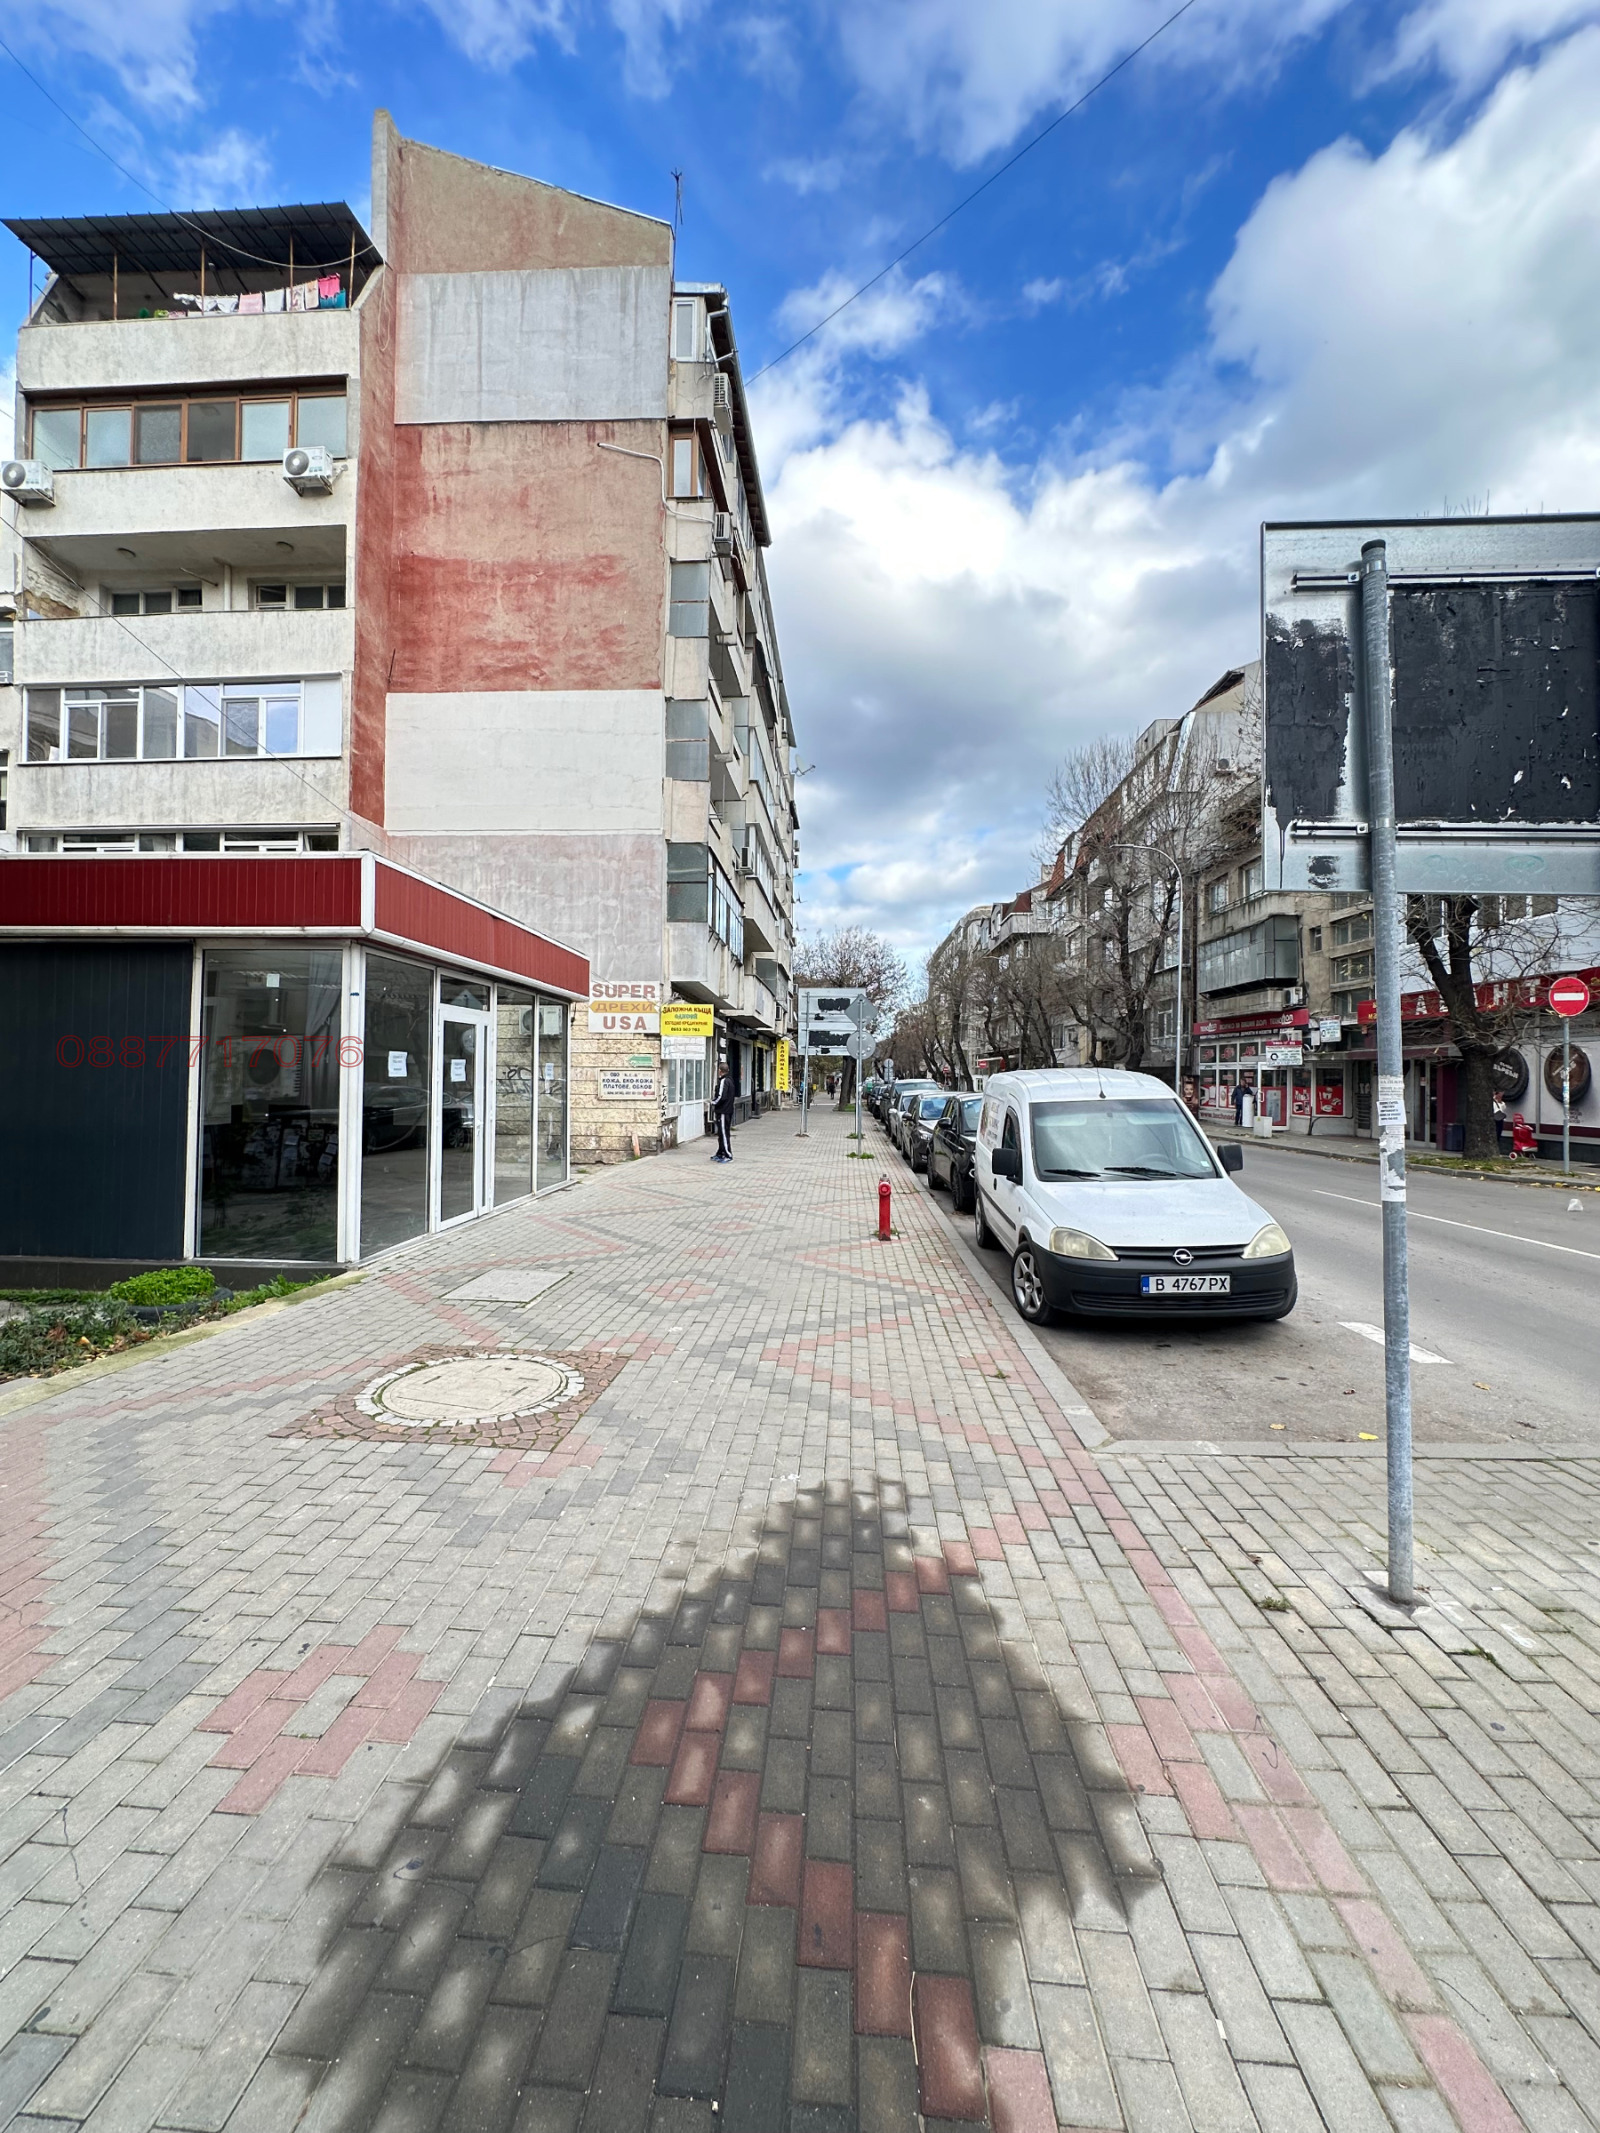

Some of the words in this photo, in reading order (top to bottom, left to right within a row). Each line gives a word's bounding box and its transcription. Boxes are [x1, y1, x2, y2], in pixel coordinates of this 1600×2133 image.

[592, 983, 656, 998] SUPER
[595, 1003, 653, 1012] ДРЕХИ
[694, 1007, 712, 1015] КЪЩА
[603, 1016, 647, 1030] USA
[1155, 1279, 1165, 1291] B
[1172, 1278, 1206, 1291] 4767
[1209, 1277, 1227, 1290] PX
